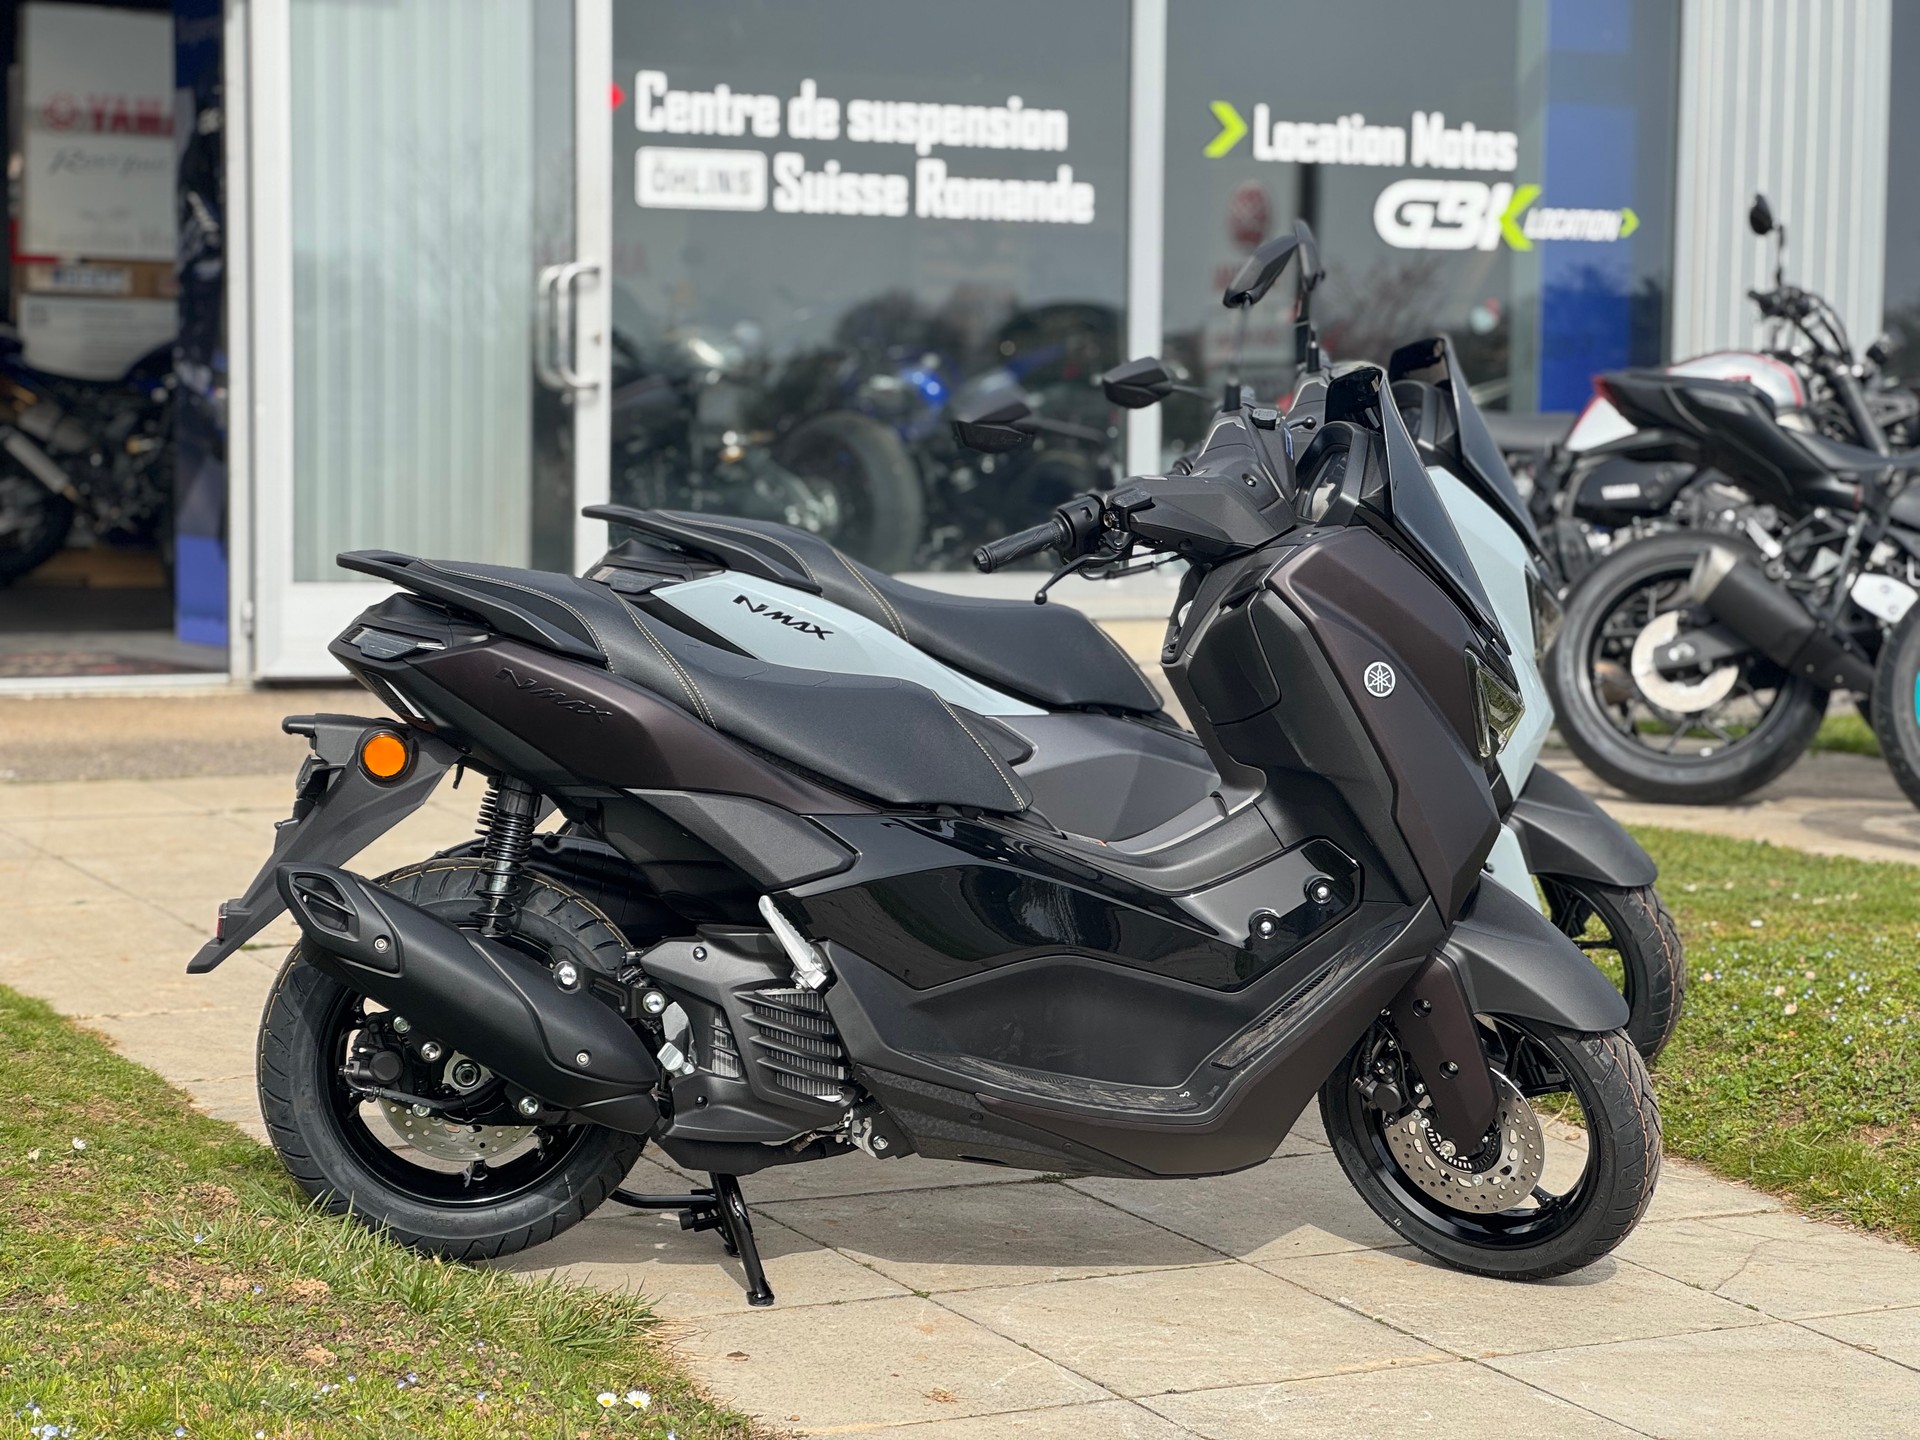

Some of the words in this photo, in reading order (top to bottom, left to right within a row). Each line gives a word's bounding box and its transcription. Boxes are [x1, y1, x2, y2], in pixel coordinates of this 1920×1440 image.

[635, 70, 780, 137] Centre
[787, 79, 840, 141] de
[847, 95, 1069, 157] suspension
[1253, 103, 1406, 167] Location
[1411, 110, 1518, 172] Motos
[773, 152, 909, 217] Suisse
[915, 158, 1095, 224] Romande
[1373, 178, 1542, 252] GBK
[1523, 207, 1623, 242] LOCATION
[733, 594, 834, 641] NMAX
[495, 667, 613, 723] NMAX
